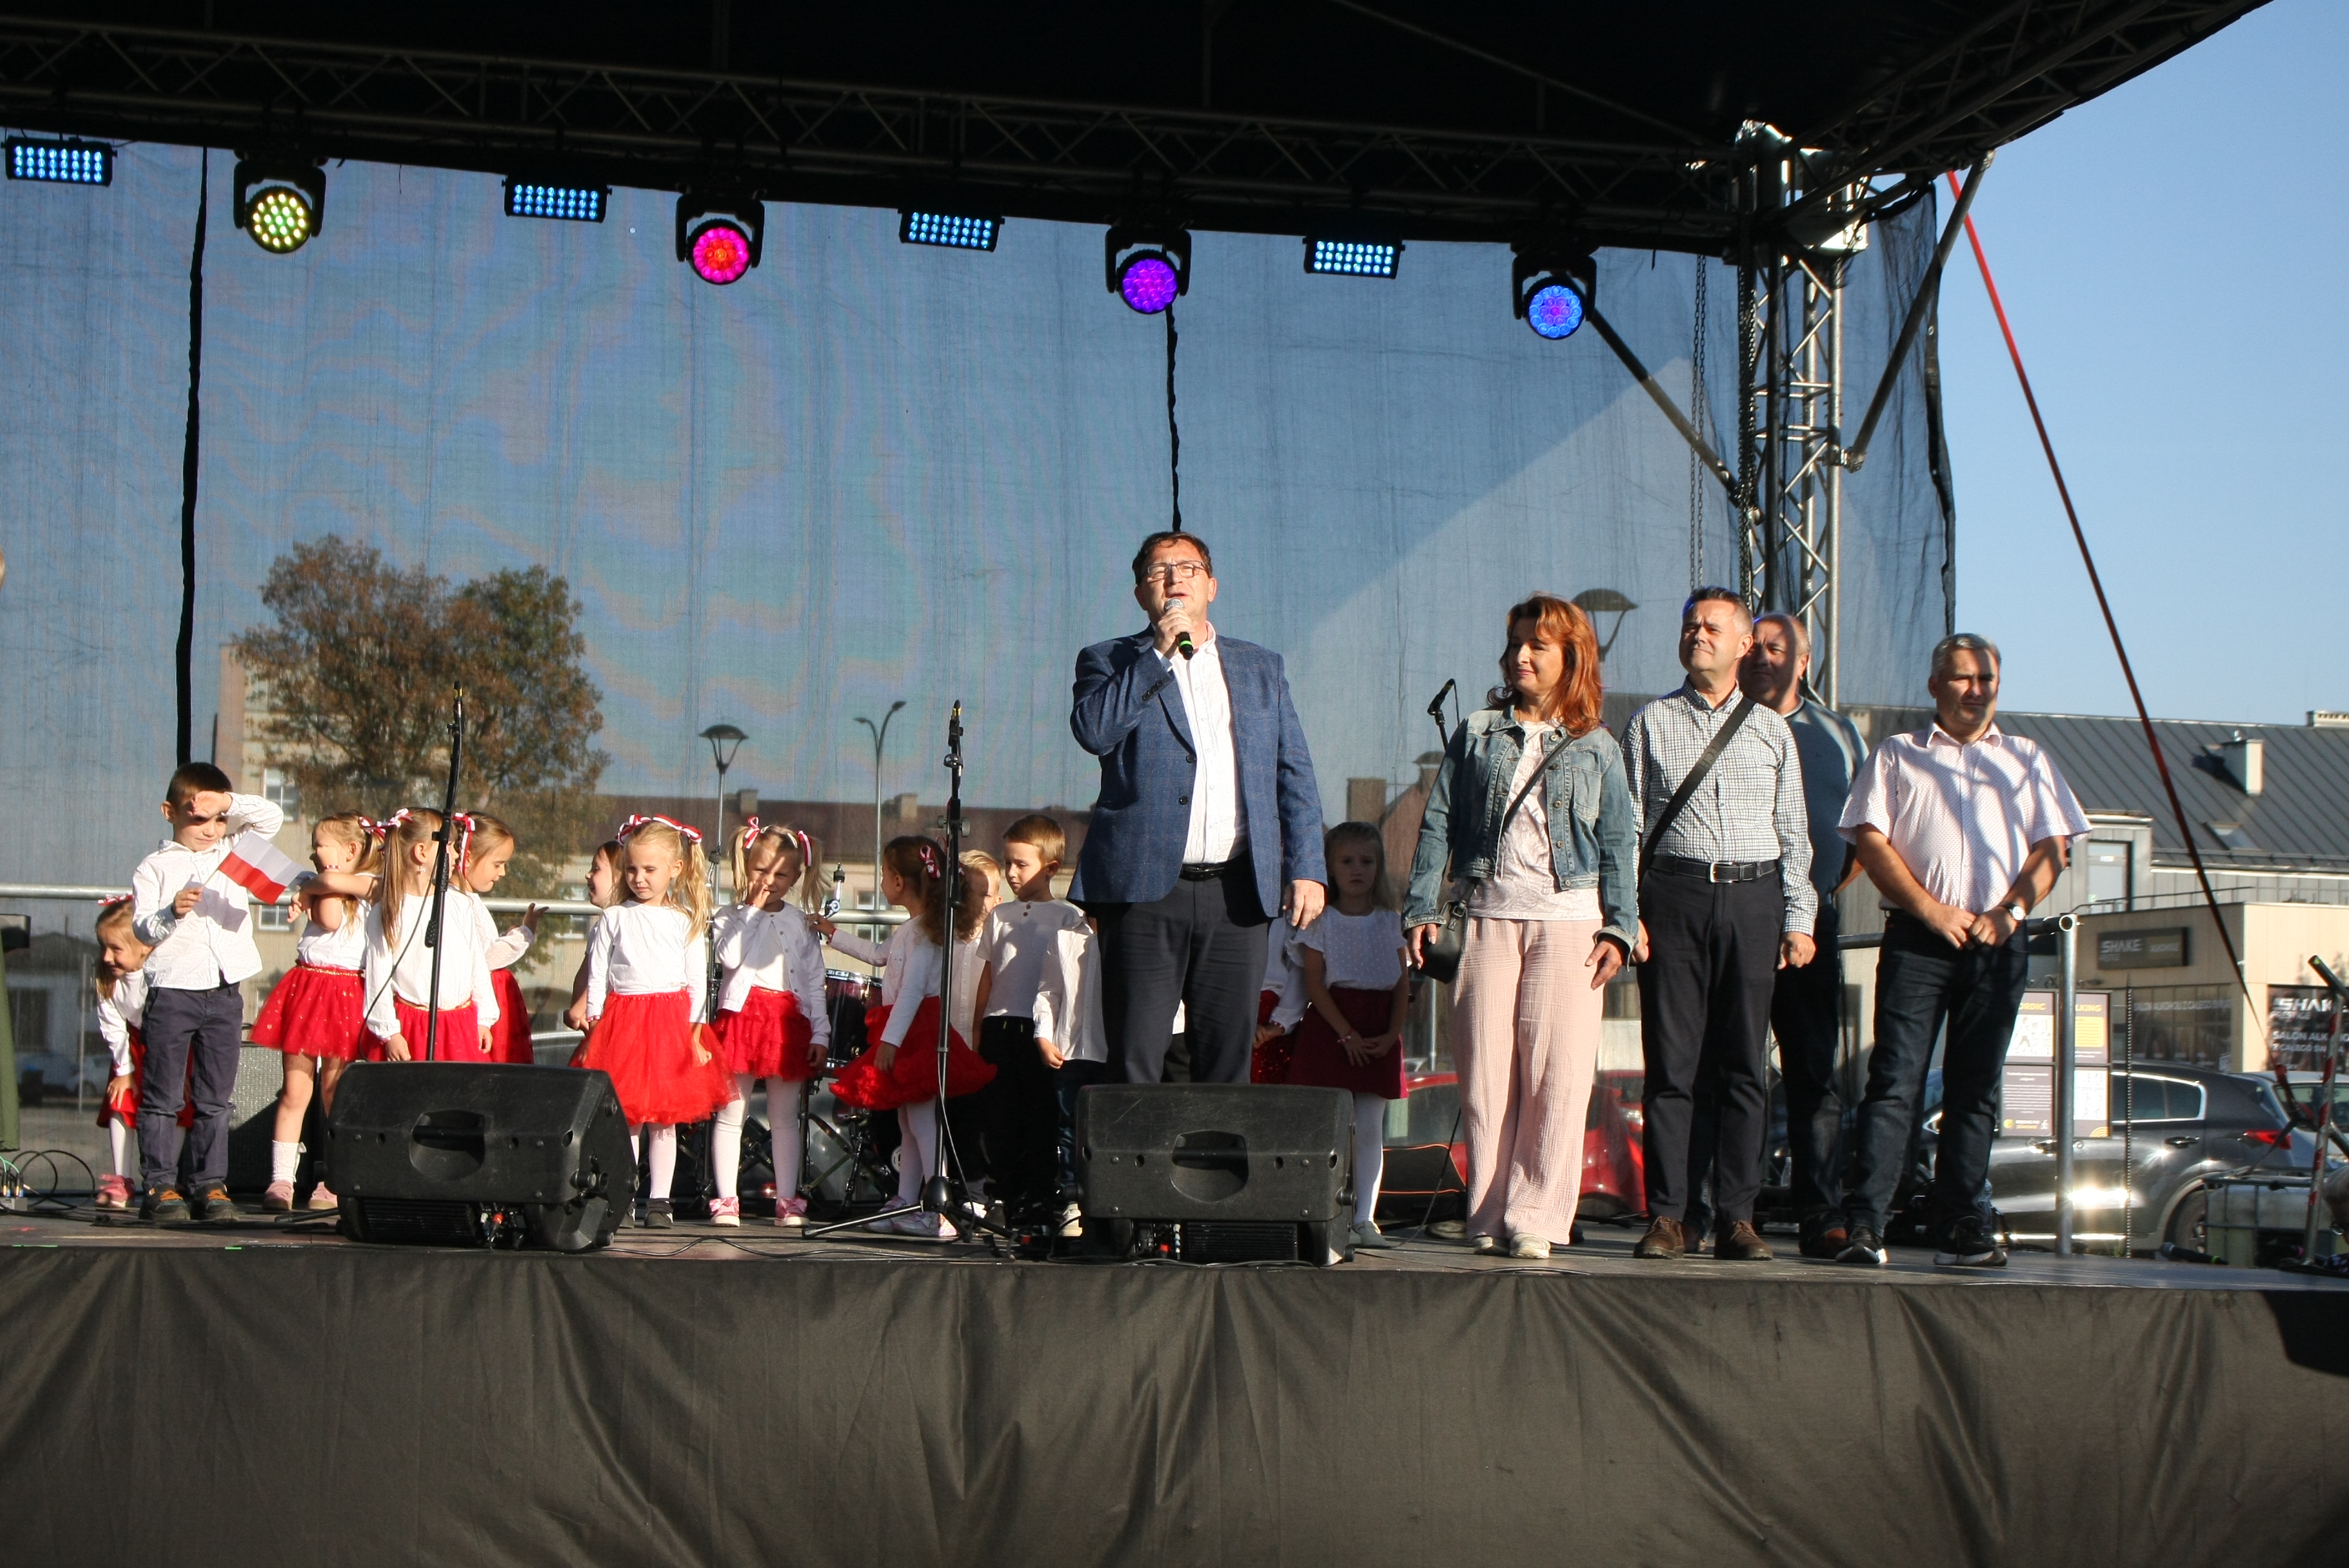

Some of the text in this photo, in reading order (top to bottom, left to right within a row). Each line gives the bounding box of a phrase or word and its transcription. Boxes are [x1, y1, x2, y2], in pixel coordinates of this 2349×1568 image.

[2100, 939, 2142, 953] SHAKE
[2272, 998, 2349, 1013] SHAK
[2272, 1031, 2307, 1040] SALON
